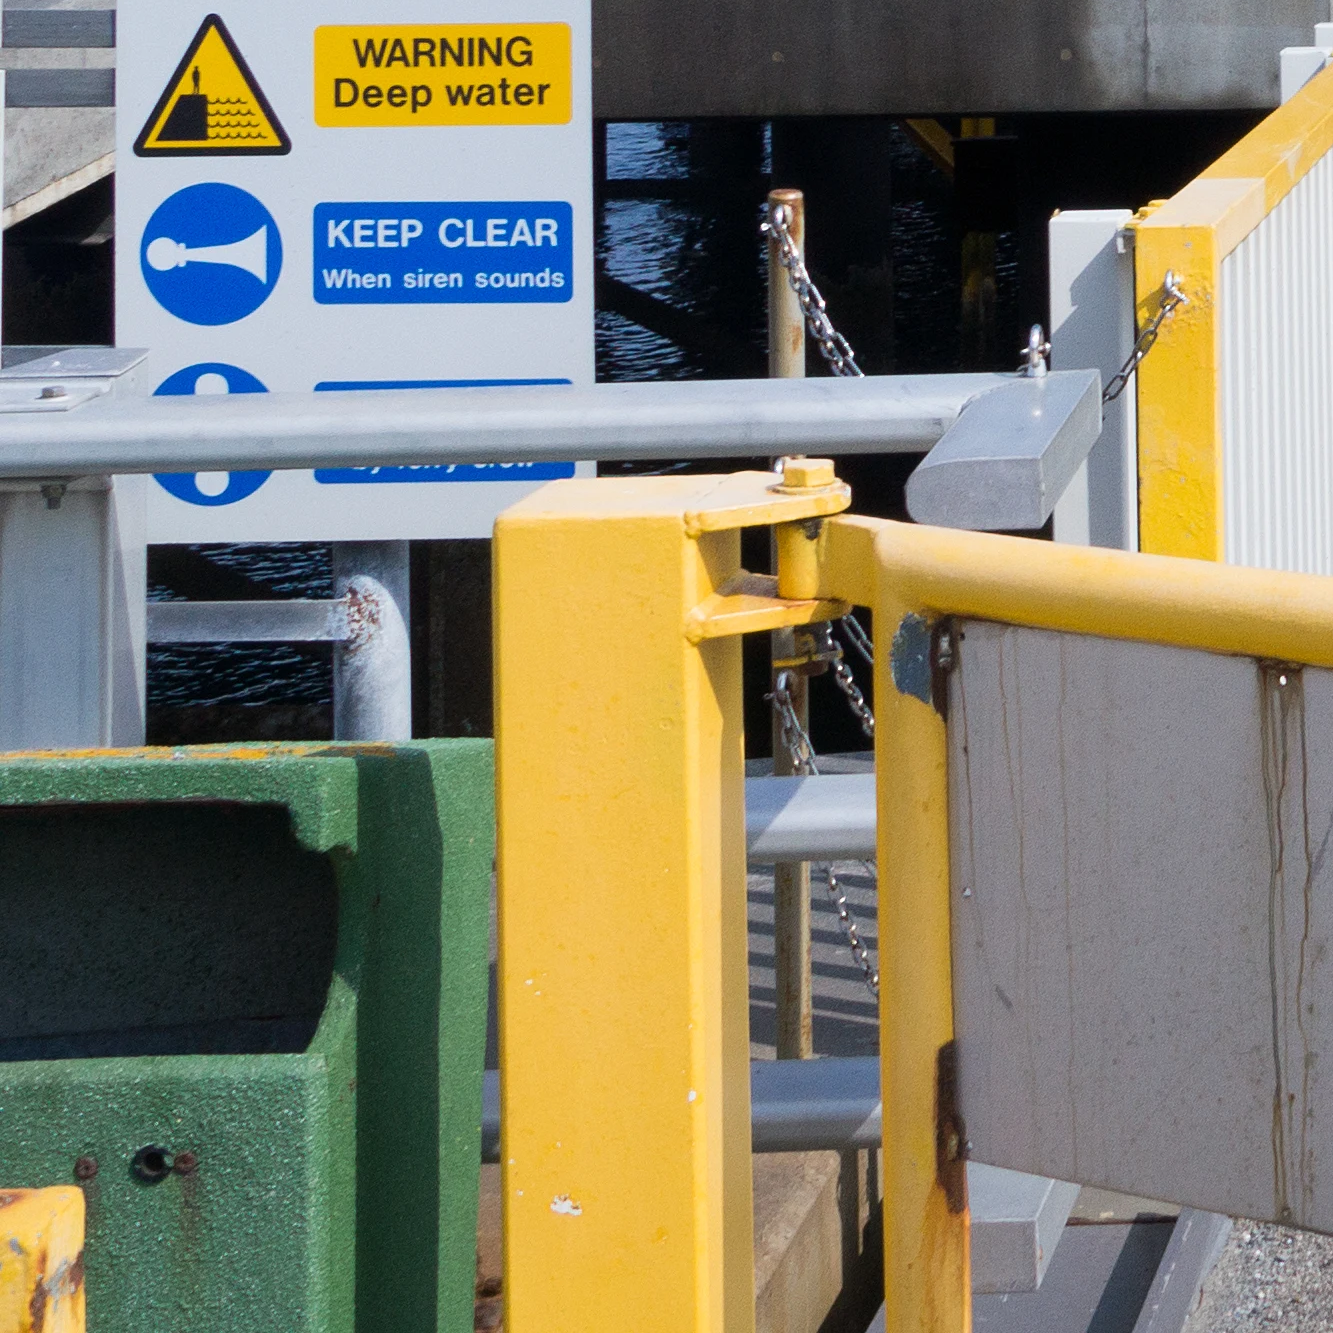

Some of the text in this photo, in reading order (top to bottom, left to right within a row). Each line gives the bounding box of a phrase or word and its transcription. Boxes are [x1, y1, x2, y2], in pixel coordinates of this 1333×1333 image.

[352, 36, 533, 68] WARNING
[334, 78, 551, 113] Deep water
[328, 218, 558, 248] KEEP CLEAR
[322, 268, 565, 289] When siren sounds
